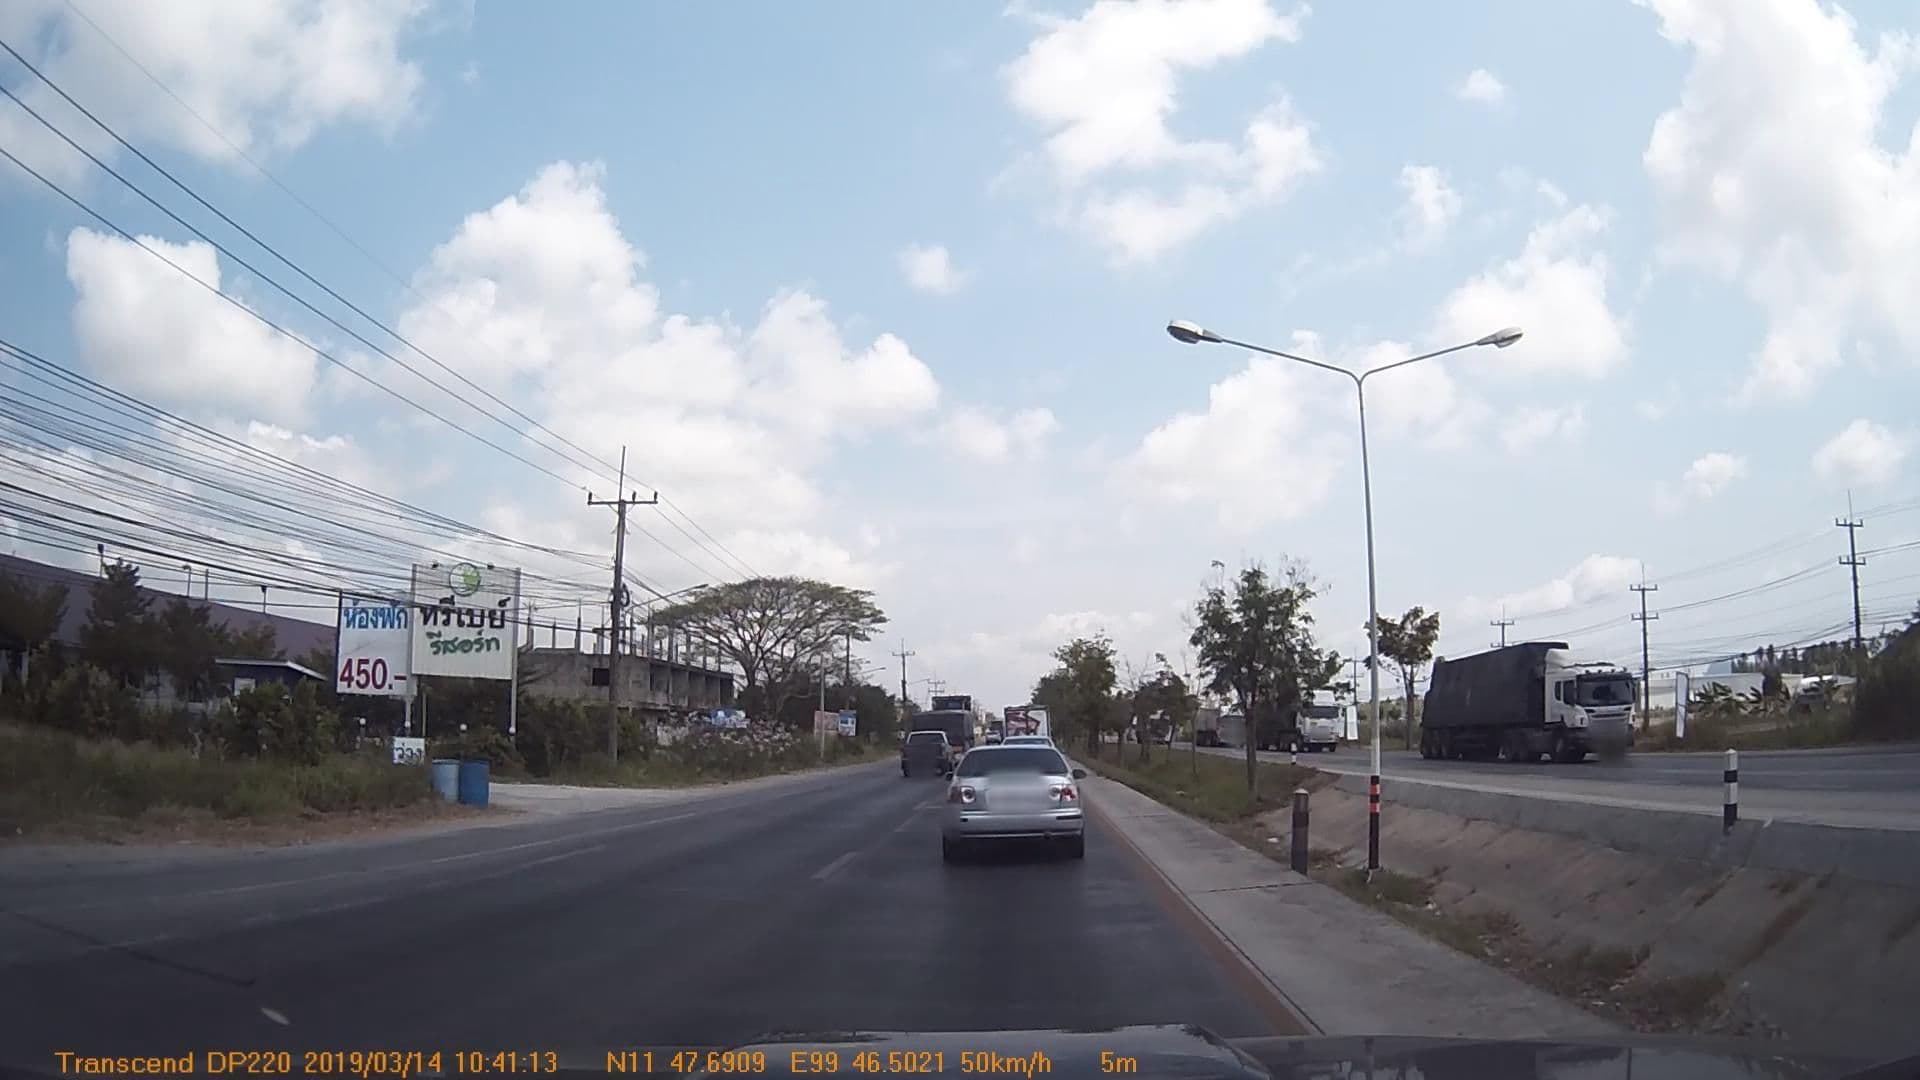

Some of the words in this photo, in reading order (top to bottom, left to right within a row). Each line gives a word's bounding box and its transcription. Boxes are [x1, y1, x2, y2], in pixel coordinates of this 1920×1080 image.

[343, 599, 408, 630] ห้องพัก
[426, 630, 501, 656] รีสอร์ท
[339, 658, 408, 691] 450.-
